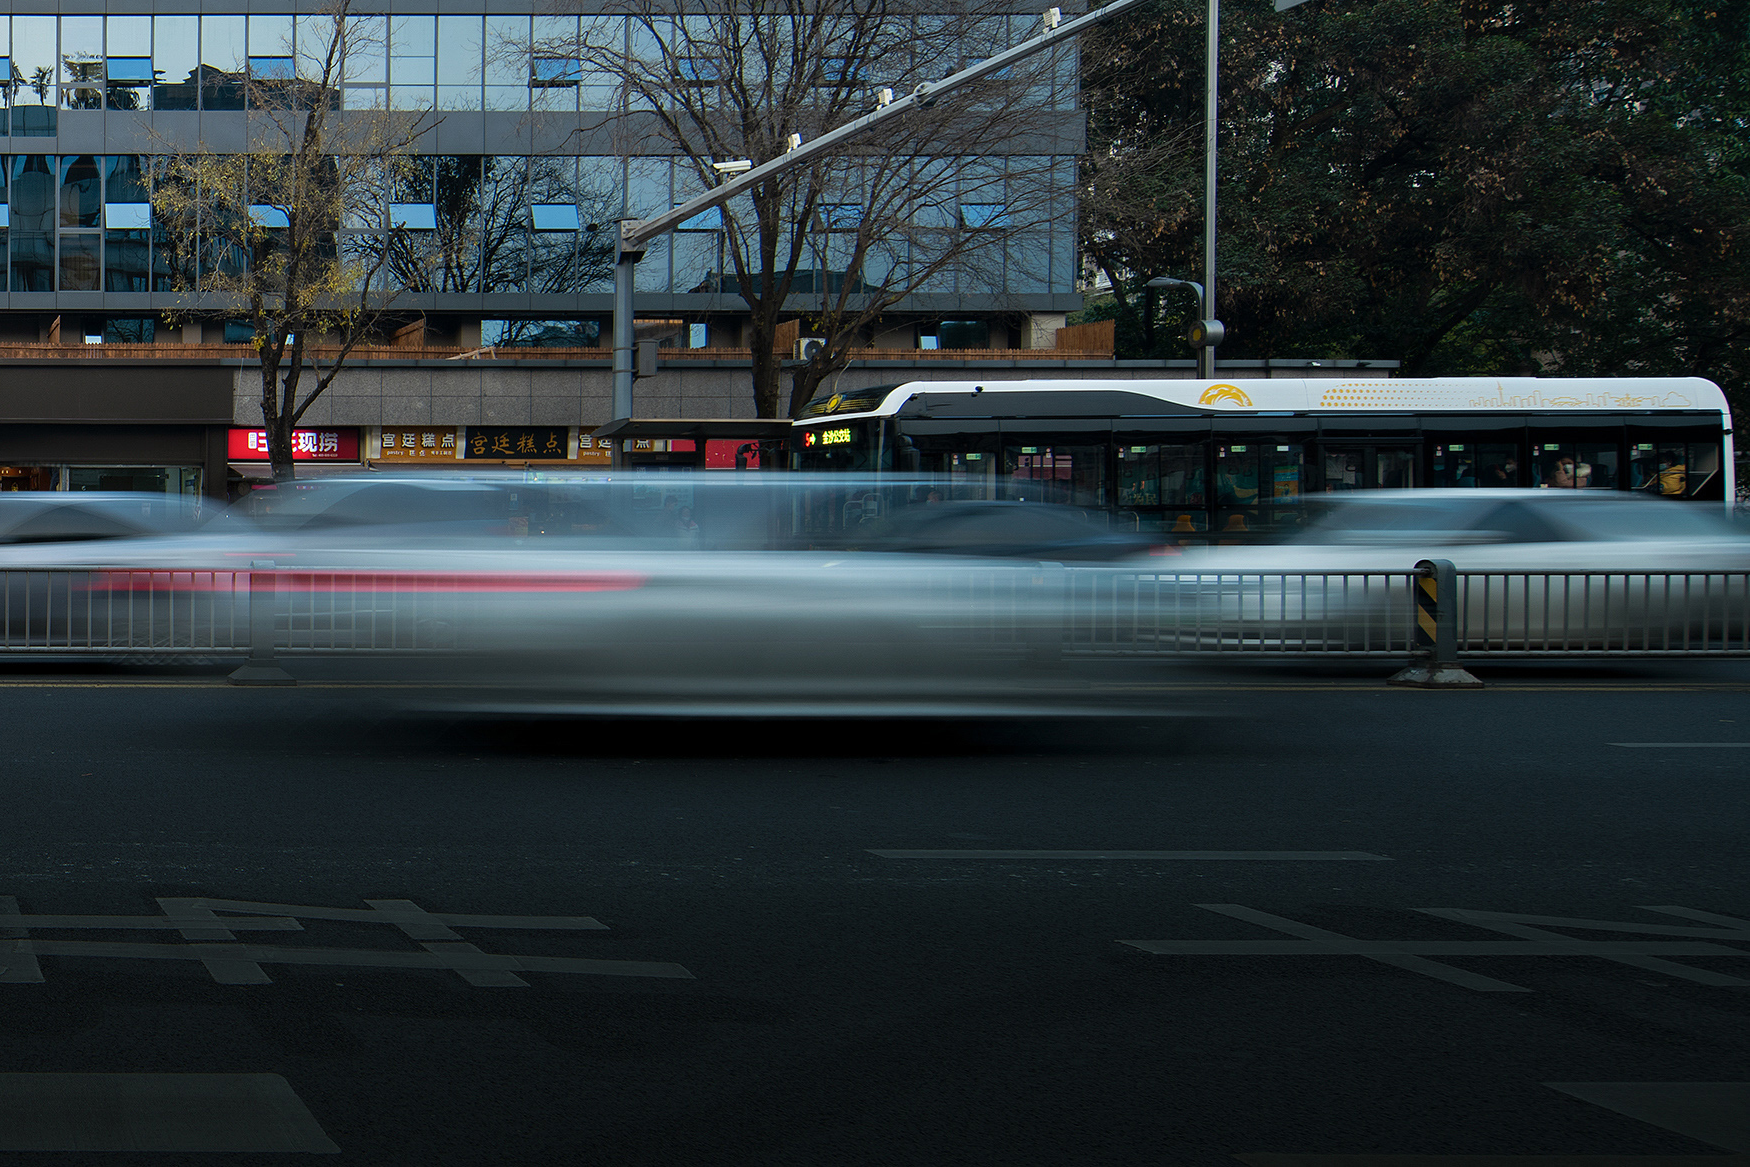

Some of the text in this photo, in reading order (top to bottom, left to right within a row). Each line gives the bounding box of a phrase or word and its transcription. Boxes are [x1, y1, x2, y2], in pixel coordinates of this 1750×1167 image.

[382, 433, 455, 448] 宫廷糕点
[470, 432, 562, 455] 宫廷糕点
